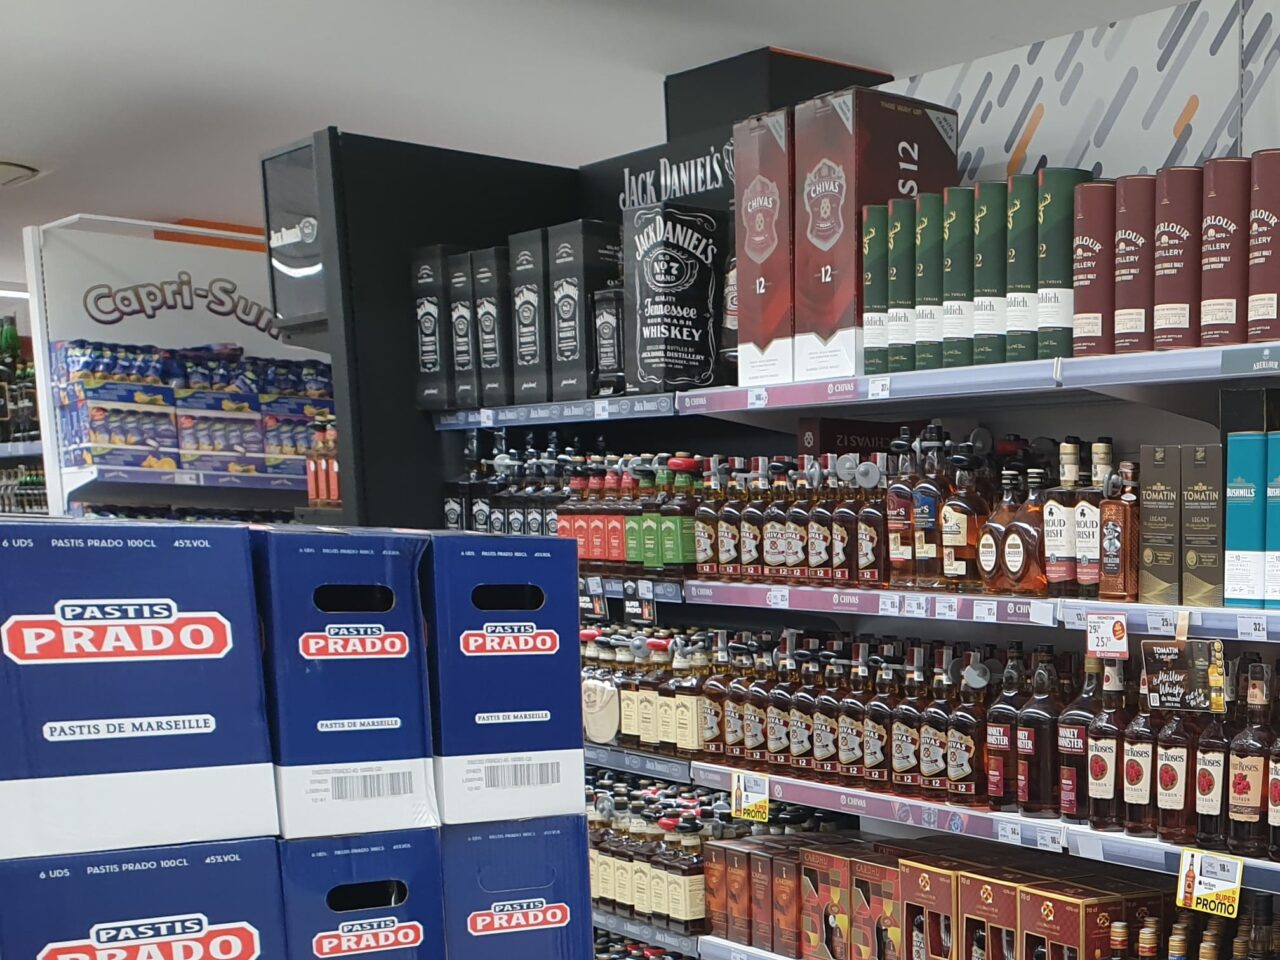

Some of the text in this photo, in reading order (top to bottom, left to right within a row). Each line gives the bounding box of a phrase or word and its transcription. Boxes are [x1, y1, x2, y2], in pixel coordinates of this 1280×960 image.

[618, 167, 657, 210] JACK
[810, 180, 839, 198] CHIVAS
[747, 197, 773, 213] CHIVAS
[634, 222, 657, 261] JACK
[821, 265, 832, 282] 12
[755, 277, 766, 294] 12
[644, 298, 698, 319] Tennessee
[642, 325, 703, 341] WHISKEY
[1142, 490, 1177, 501] TOMATIN
[1183, 491, 1219, 501] TOMATIN
[2, 539, 34, 547] 6 UDS
[51, 539, 157, 547] PASTIS PRADO 100CL
[64, 604, 170, 619] PASTIS
[329, 627, 381, 635] PASTIS
[487, 625, 534, 634] PASTIS
[21, 624, 214, 655] PRADO
[309, 637, 401, 654] PRADO
[468, 635, 551, 650] PRADO
[49, 718, 211, 737] PASTIS DE MARSEILLE
[39, 869, 70, 879] 6 UDS
[86, 858, 189, 875] PASTIS PRADO 100CL
[495, 900, 542, 912] PASTIS
[1195, 896, 1235, 915] PROMO
[1215, 893, 1236, 903] SUPER
[342, 920, 394, 932] PASTIS
[476, 908, 562, 930] PRADO
[100, 919, 200, 942] PASTIS
[321, 928, 415, 952] PRADO
